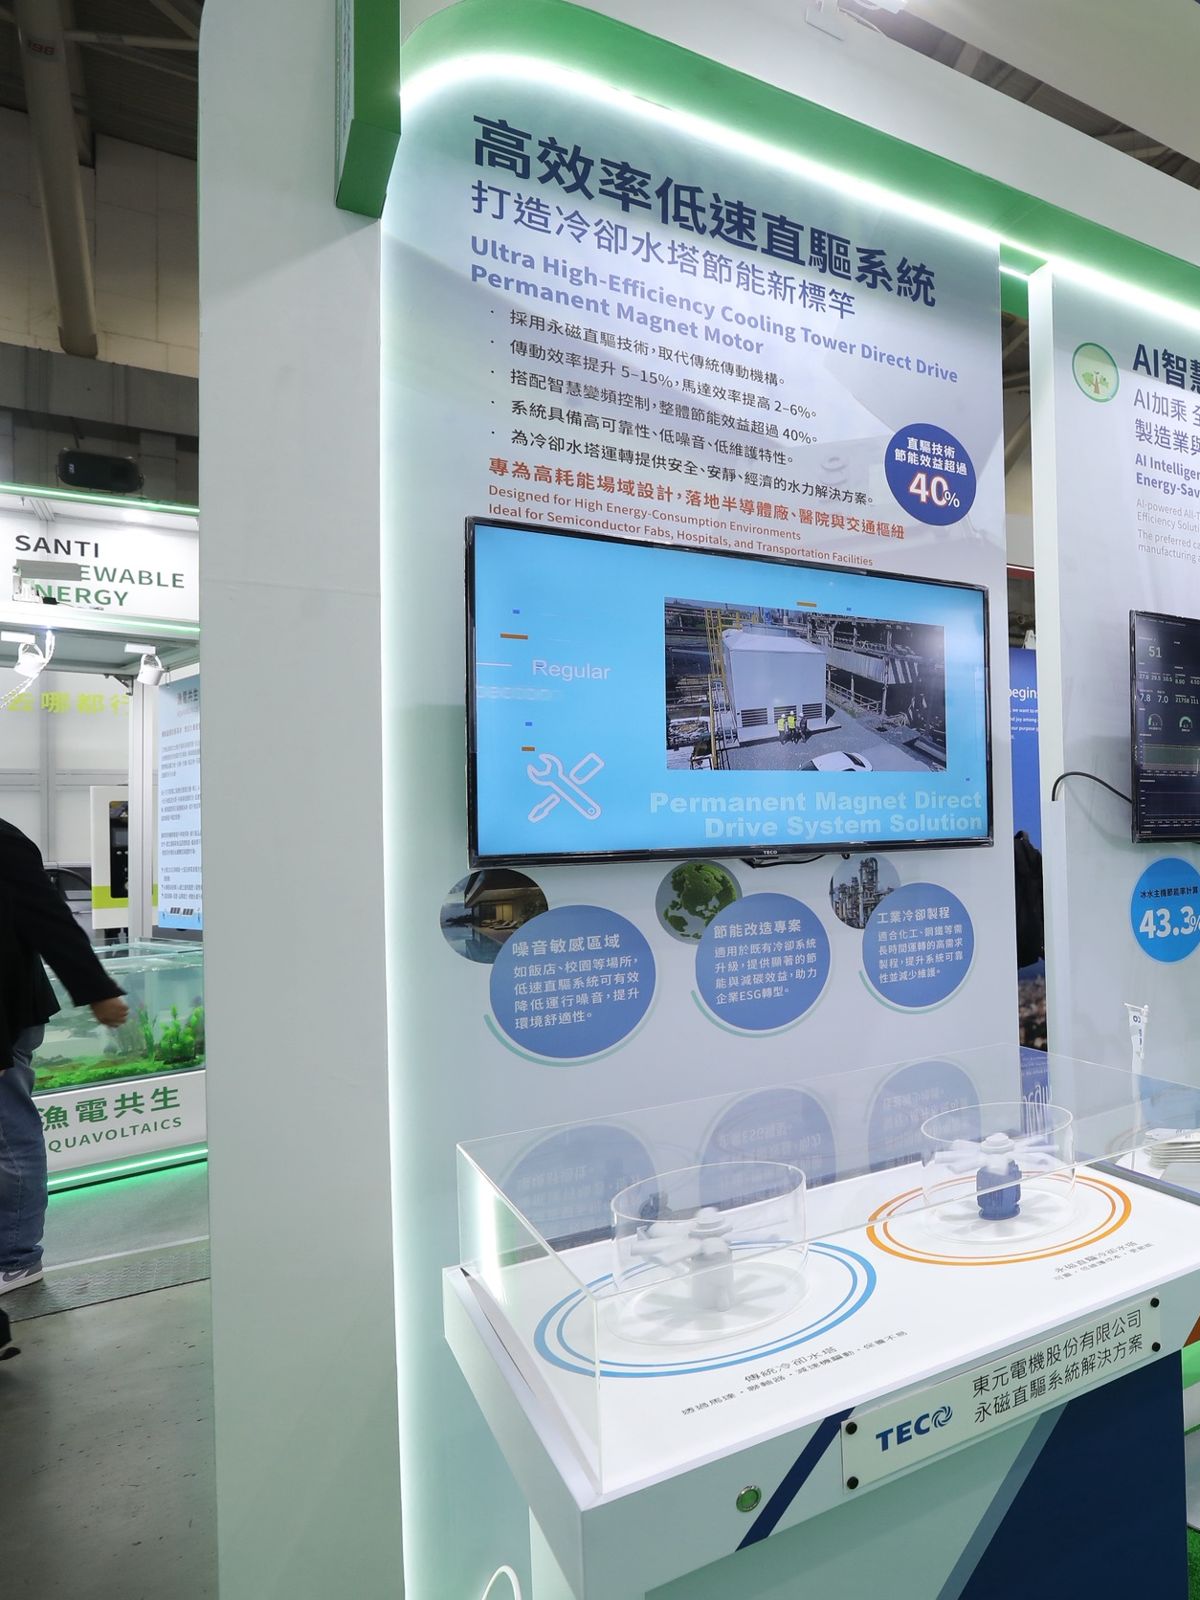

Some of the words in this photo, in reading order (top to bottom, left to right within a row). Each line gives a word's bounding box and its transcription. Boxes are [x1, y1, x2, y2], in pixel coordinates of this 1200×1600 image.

[472, 115, 936, 308] 高效率低速直驅系統
[471, 179, 856, 320] 打造冷卻水塔節能新標竿
[470, 235, 536, 272] Ultra
[543, 254, 715, 321] High-Efficiency
[720, 304, 796, 343] Cooling
[800, 327, 856, 355] Tower
[862, 342, 912, 371] Direct
[916, 358, 958, 383] Drive
[470, 264, 610, 317] Permanent
[616, 301, 699, 340] Magnet
[704, 326, 764, 354] Motor
[510, 338, 616, 376] 傳動效率提升
[1133, 387, 1188, 420] AI加乘
[907, 436, 955, 459] 直驅技術
[1136, 453, 1147, 466] AI
[894, 448, 968, 476] 節能效益超過
[909, 472, 960, 508] 40%
[488, 484, 550, 504] Designed
[554, 494, 572, 506] for
[574, 496, 603, 513] High
[606, 502, 727, 530] Energy-Consumption
[730, 522, 801, 540] Environments
[1136, 499, 1182, 517] AI-powered
[1137, 512, 1176, 530] Efficiency
[15, 535, 99, 558] SANTI
[488, 503, 522, 517] Ideal
[524, 508, 544, 521] for
[547, 510, 641, 534] Semiconductor
[644, 524, 674, 540] Fabs,
[677, 530, 732, 549] Hospitals,
[734, 536, 754, 549] and
[757, 540, 830, 561] Transportation
[832, 552, 874, 567] Facilities
[1138, 529, 1153, 541] The
[1154, 533, 1191, 549] preferred
[1138, 543, 1196, 564] manufacturing
[80, 564, 185, 589] EWABLE
[33, 583, 129, 606] NERGY
[1148, 646, 1162, 658] 51
[532, 659, 611, 682] Regular
[1008, 686, 1038, 702] egin
[650, 792, 806, 814] Permanent
[816, 791, 906, 815] Magnet
[914, 790, 982, 810] Direct
[705, 818, 778, 839] Drive
[786, 816, 882, 840] System
[890, 812, 982, 833] Solution
[877, 906, 951, 925] 工業冷卻製程
[713, 918, 802, 940] 節能改造專案
[512, 934, 620, 958] 噪音敏感區域
[714, 937, 816, 959] 適用於既有冷卻系統
[514, 972, 640, 996] 低速直驅系統可有效
[38, 1086, 180, 1132] 漁電共生
[48, 1117, 182, 1153] QUAVOLTAICS
[972, 1309, 1142, 1398] 東元電機股份有限公司
[974, 1333, 1143, 1424] 永磁直驅系統解決方案
[876, 1404, 953, 1452] TECO
